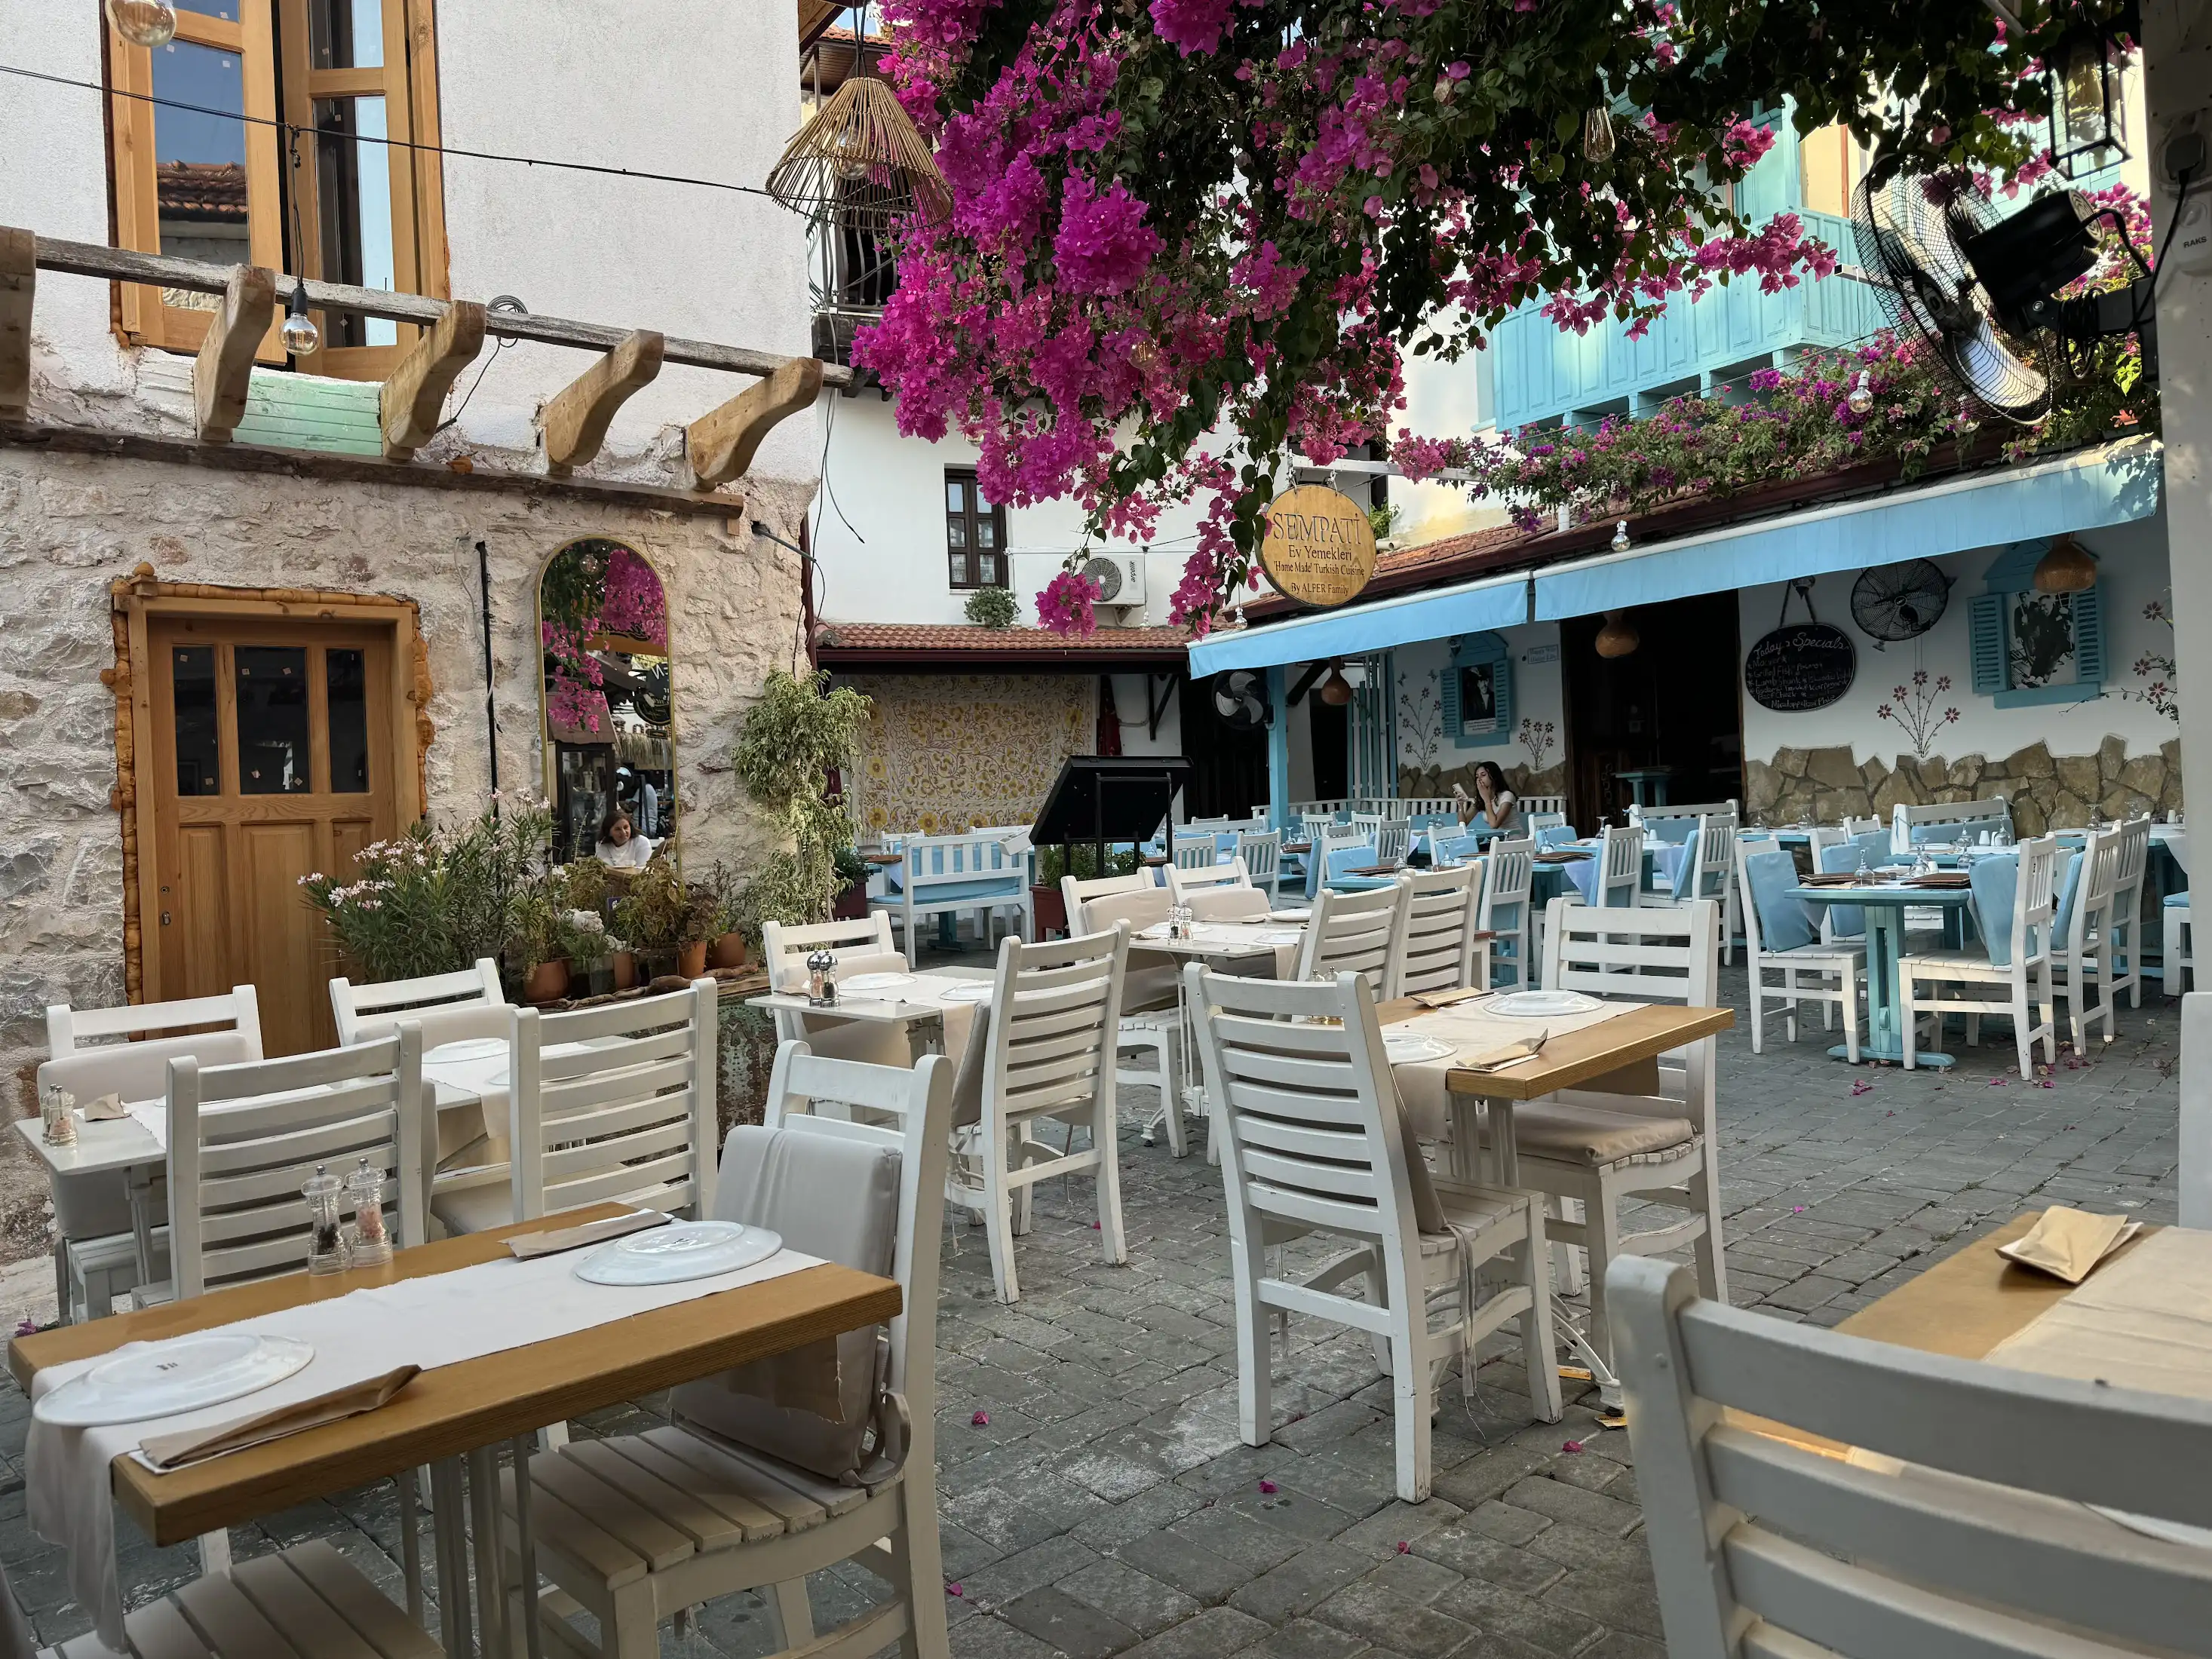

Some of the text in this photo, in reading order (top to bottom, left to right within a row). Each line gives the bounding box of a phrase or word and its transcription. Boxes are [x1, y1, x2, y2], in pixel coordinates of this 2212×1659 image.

[2183, 236, 2207, 248] RAKS
[1273, 513, 1361, 544] SEMPATİ
[1288, 544, 1352, 561] Ev Yemekleri
[1313, 563, 1339, 575] Turkish
[1341, 564, 1364, 576] Cuisine
[1290, 582, 1349, 596] By ALPER Family
[1755, 676, 1778, 687] Lamb
